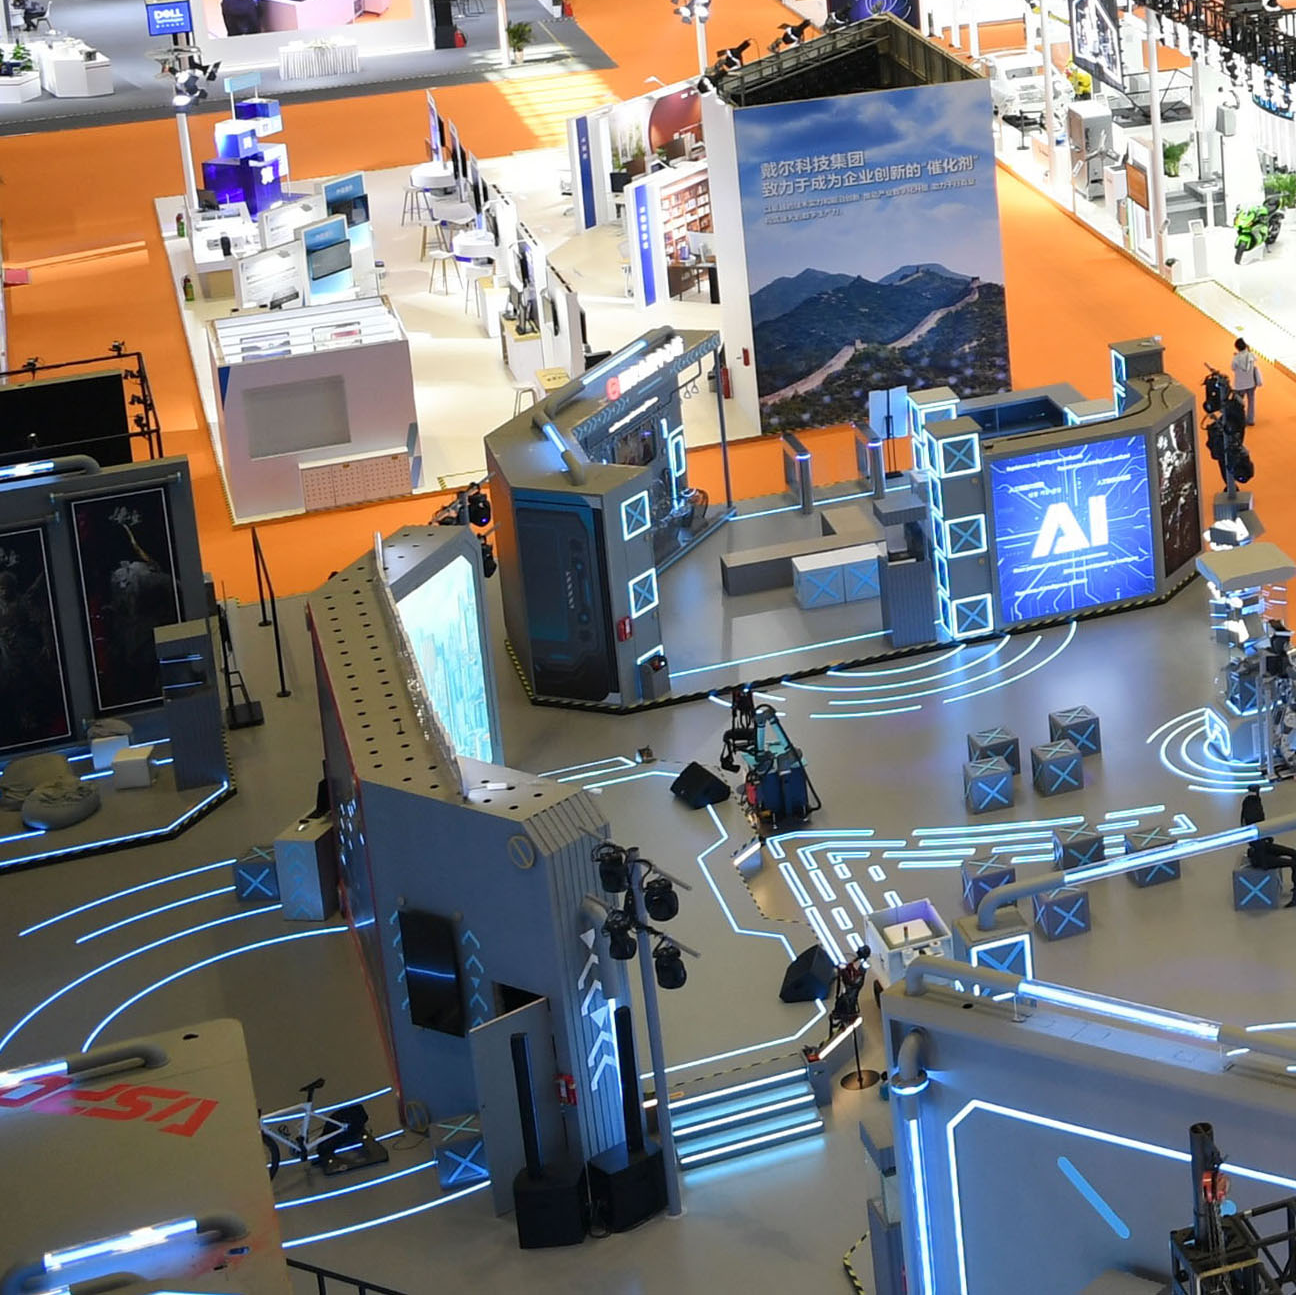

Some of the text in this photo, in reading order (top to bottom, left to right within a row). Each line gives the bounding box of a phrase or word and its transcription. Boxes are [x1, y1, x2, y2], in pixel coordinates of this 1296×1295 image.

[153, 8, 184, 20] DELL
[761, 151, 864, 179] 戴尔科技集团
[1031, 494, 1109, 559] AI
